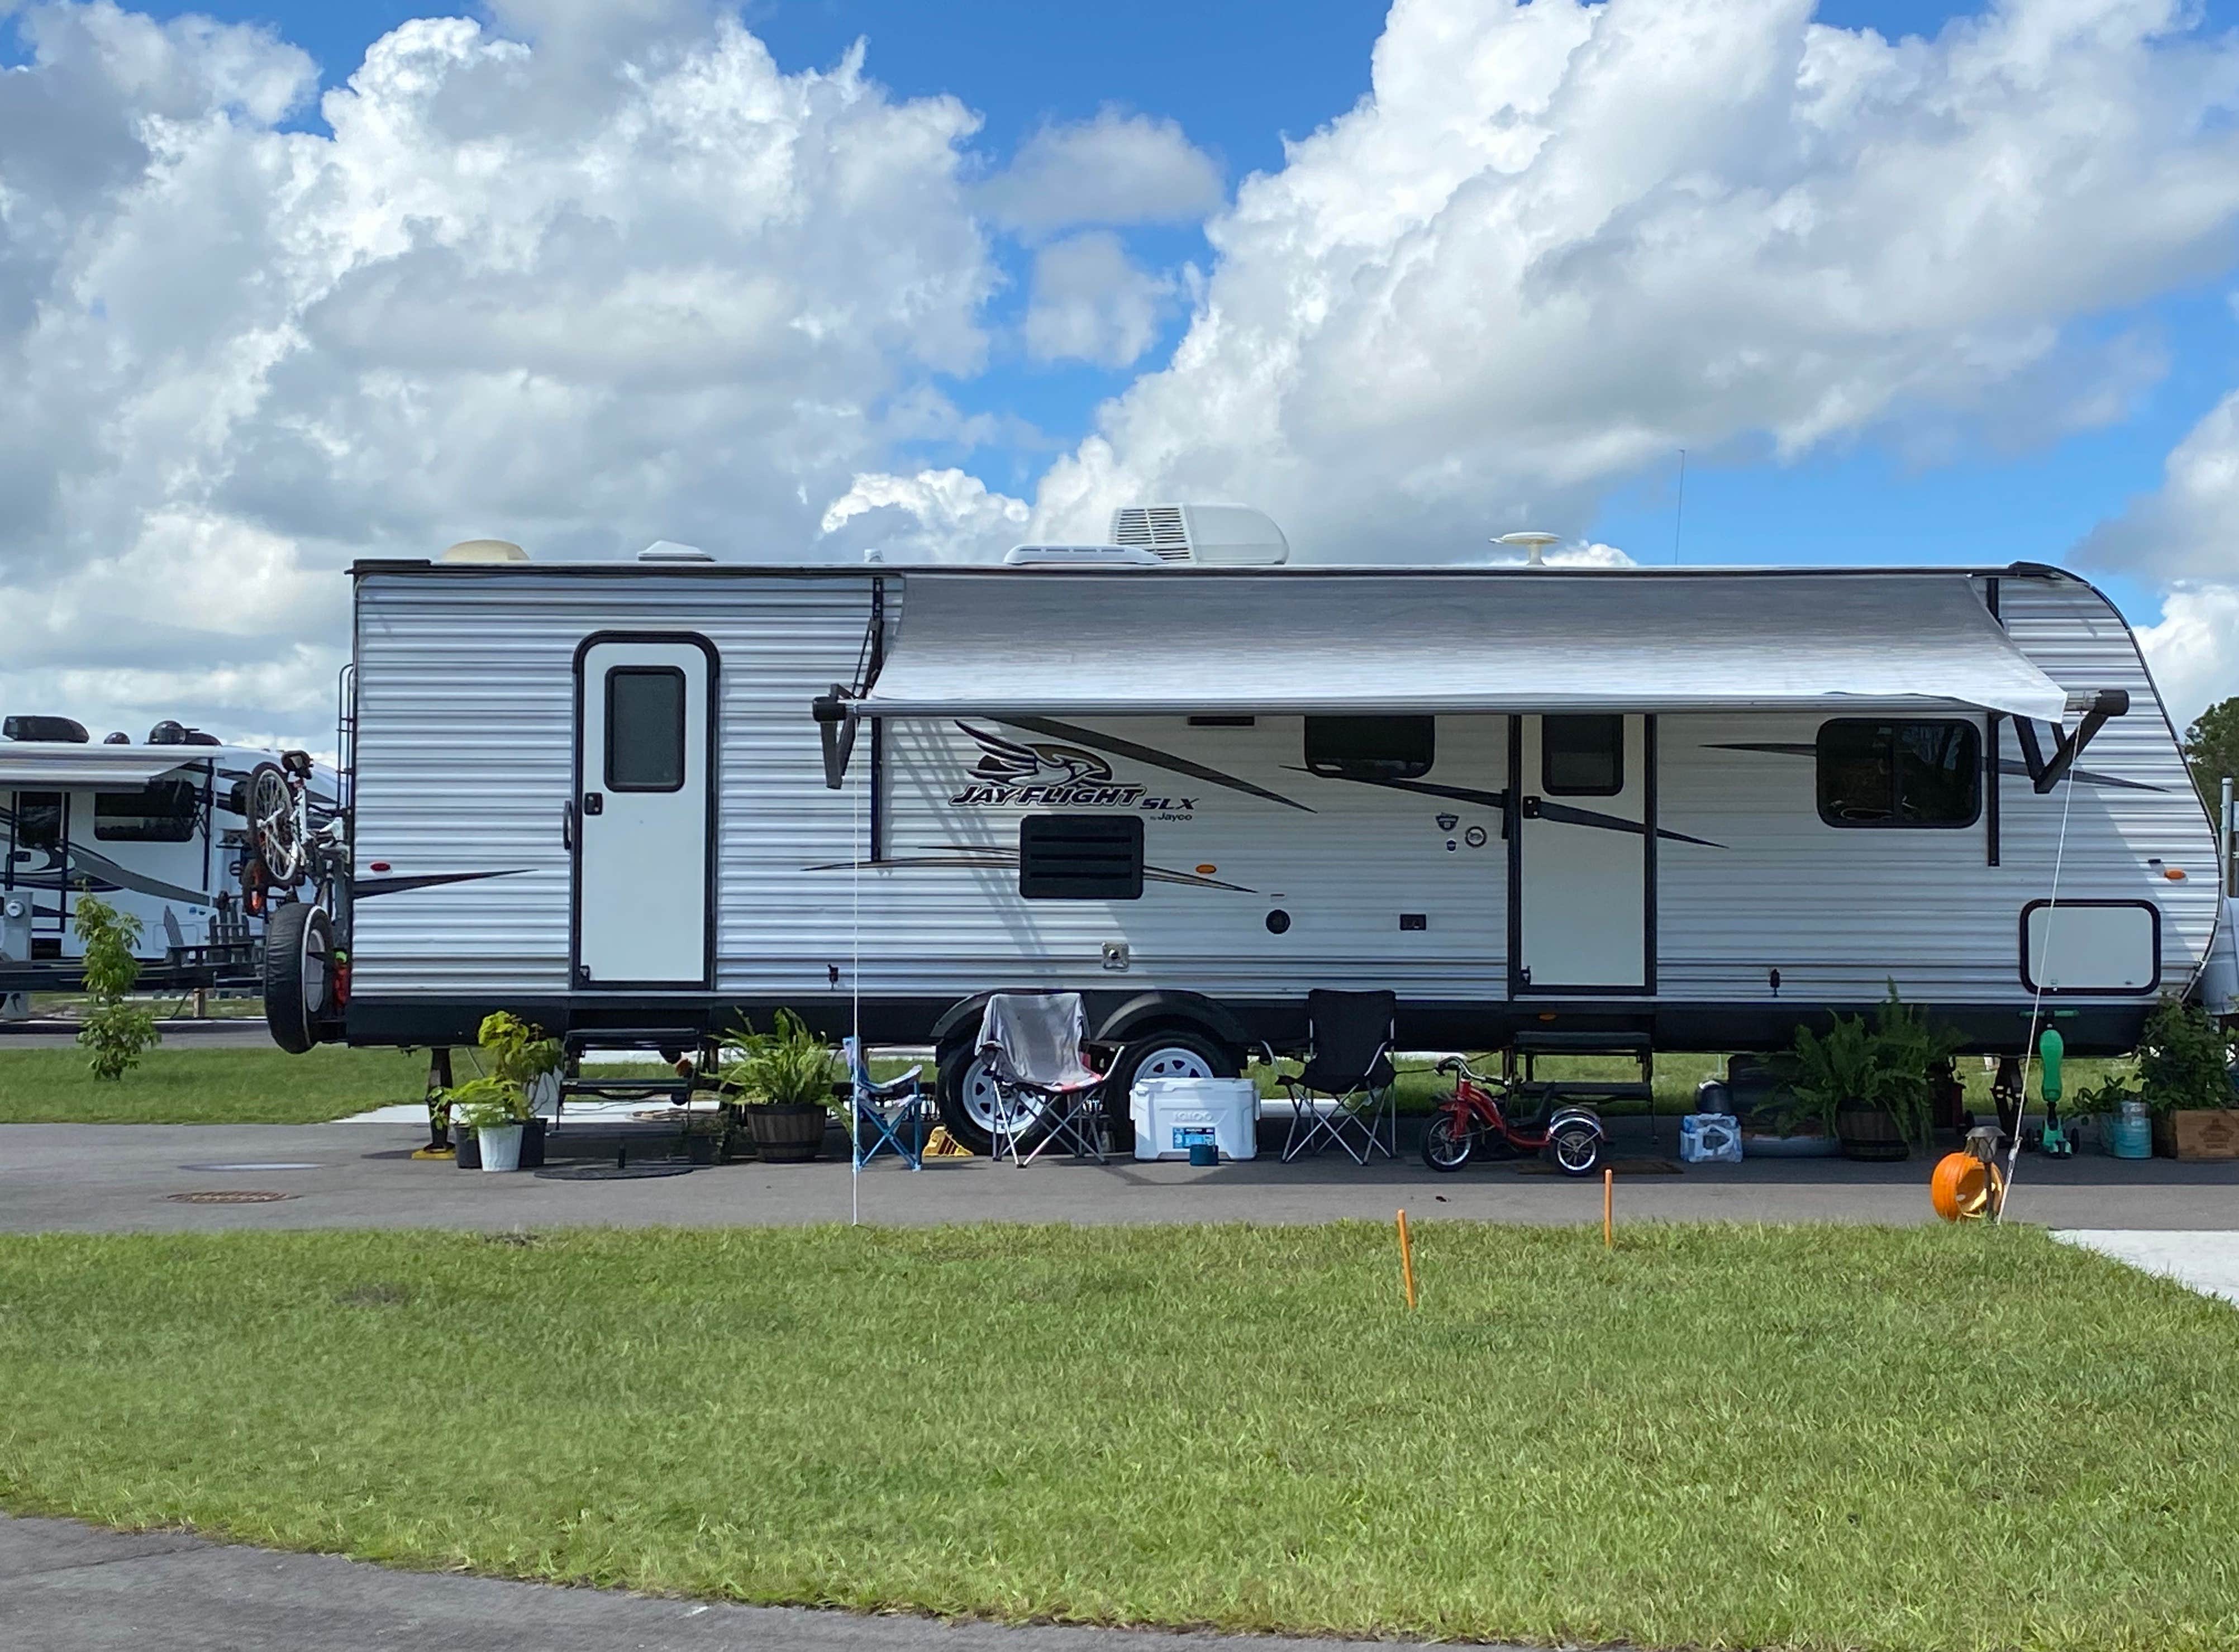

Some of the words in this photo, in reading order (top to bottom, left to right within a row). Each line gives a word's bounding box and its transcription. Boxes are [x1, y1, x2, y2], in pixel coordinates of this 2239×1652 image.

[949, 784, 1022, 805] JAY
[1016, 784, 1147, 805] FLIGHT
[1140, 798, 1199, 810] SLX
[1157, 812, 1193, 822] Jayco
